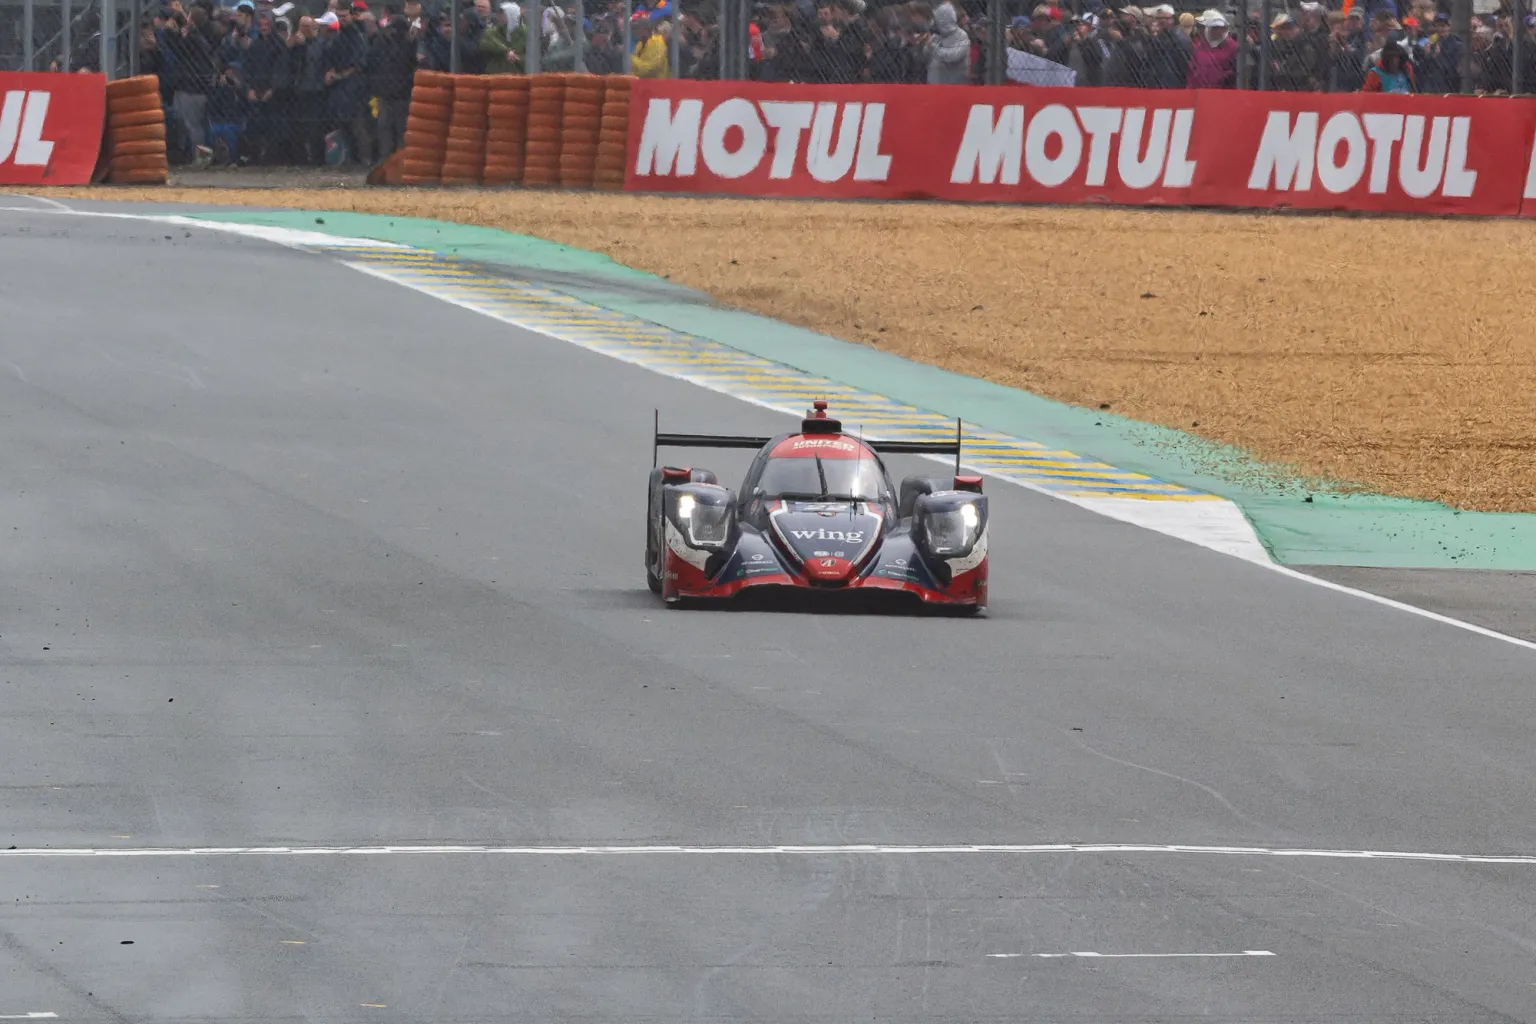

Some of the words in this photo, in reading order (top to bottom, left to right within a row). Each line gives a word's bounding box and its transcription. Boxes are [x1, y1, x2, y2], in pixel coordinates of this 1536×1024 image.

[636, 97, 893, 183] MOTUL
[950, 104, 1198, 190] MOTUL
[1248, 111, 1478, 199] MOTUL
[790, 528, 864, 544] wing
